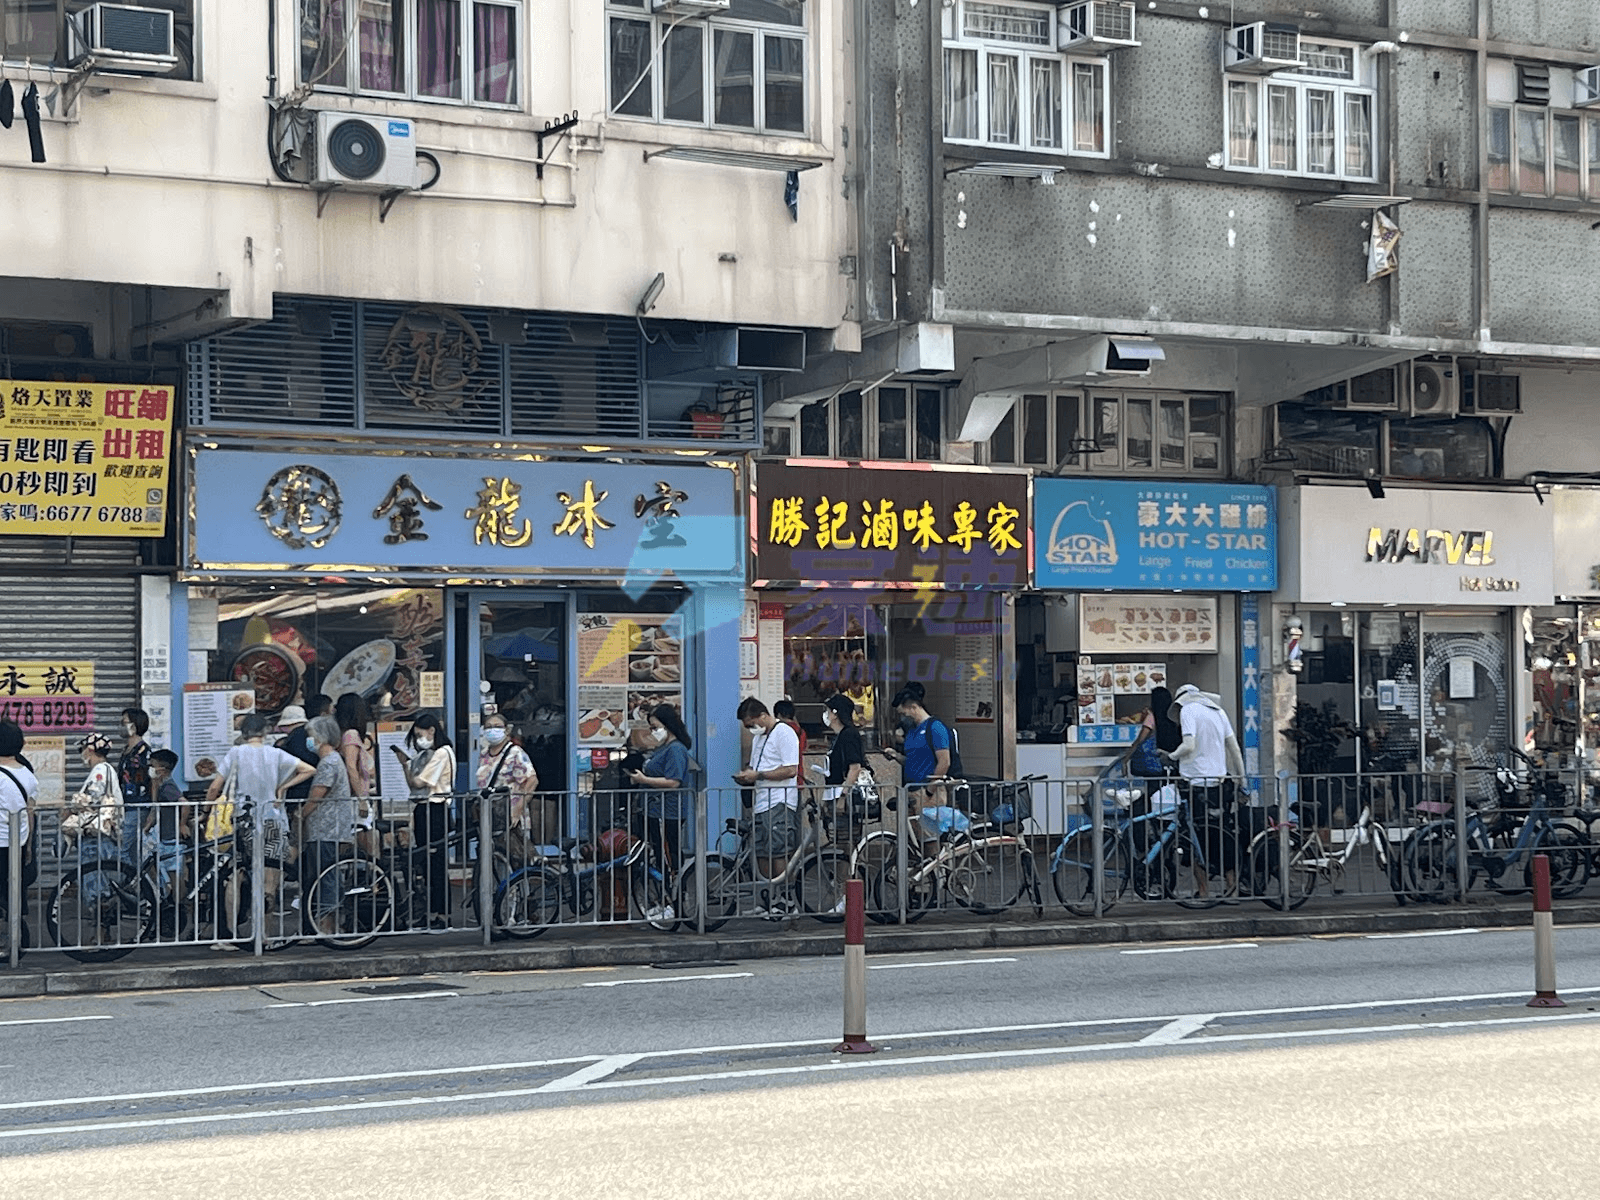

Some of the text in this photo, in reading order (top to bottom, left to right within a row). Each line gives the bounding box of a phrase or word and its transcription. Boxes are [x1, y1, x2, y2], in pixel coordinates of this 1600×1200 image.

[11, 387, 93, 408] 烙天置業
[102, 428, 165, 460] 出租
[0, 471, 97, 497] 0秒即到
[98, 506, 143, 523] 6788
[372, 473, 690, 550] 金龍冰室
[769, 496, 1022, 556] 勝記滷味專家
[1051, 550, 1113, 563] STAR
[1364, 526, 1497, 566] MARVEL
[1139, 556, 1268, 570] Large Fried Chicken
[0, 665, 81, 696] 永誠
[43, 701, 87, 727] 8299
